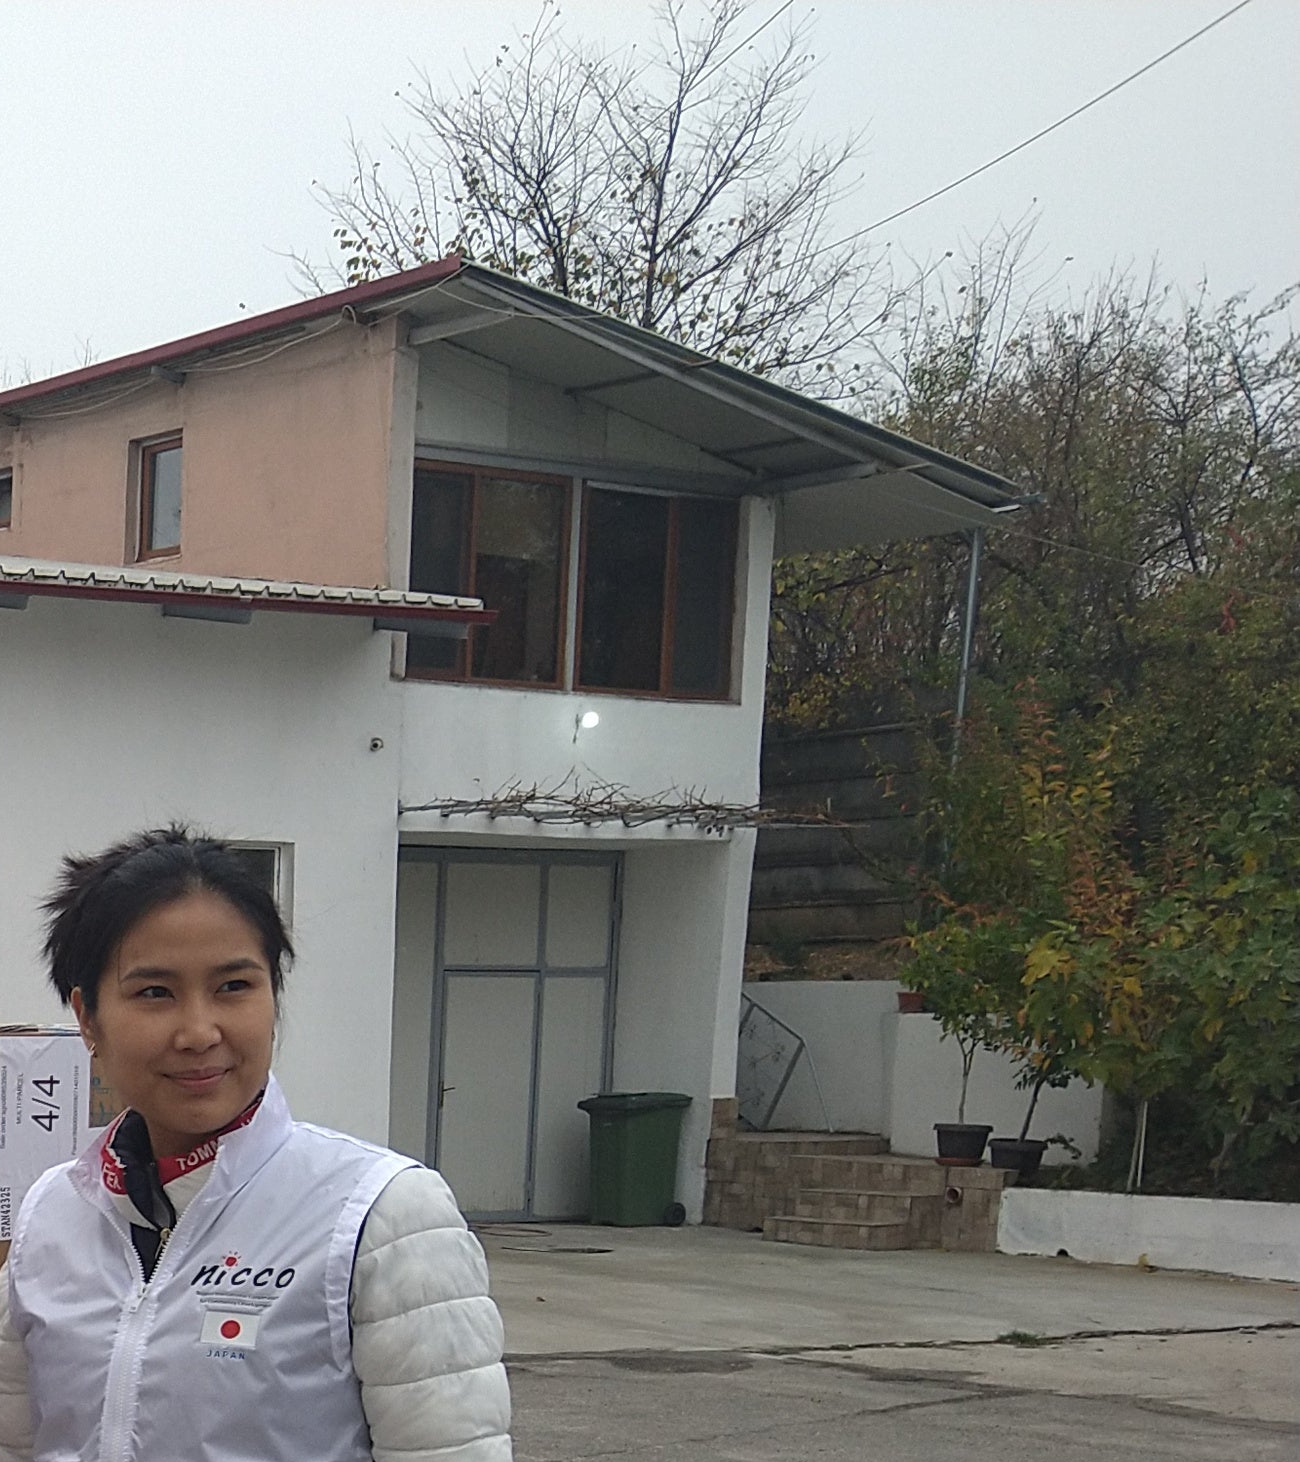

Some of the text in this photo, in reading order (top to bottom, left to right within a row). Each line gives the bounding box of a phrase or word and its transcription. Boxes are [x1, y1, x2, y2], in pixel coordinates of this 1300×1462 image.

[31, 1075, 60, 1132] 4/4
[190, 1257, 296, 1289] nicco
[206, 1350, 246, 1360] JAPAN
